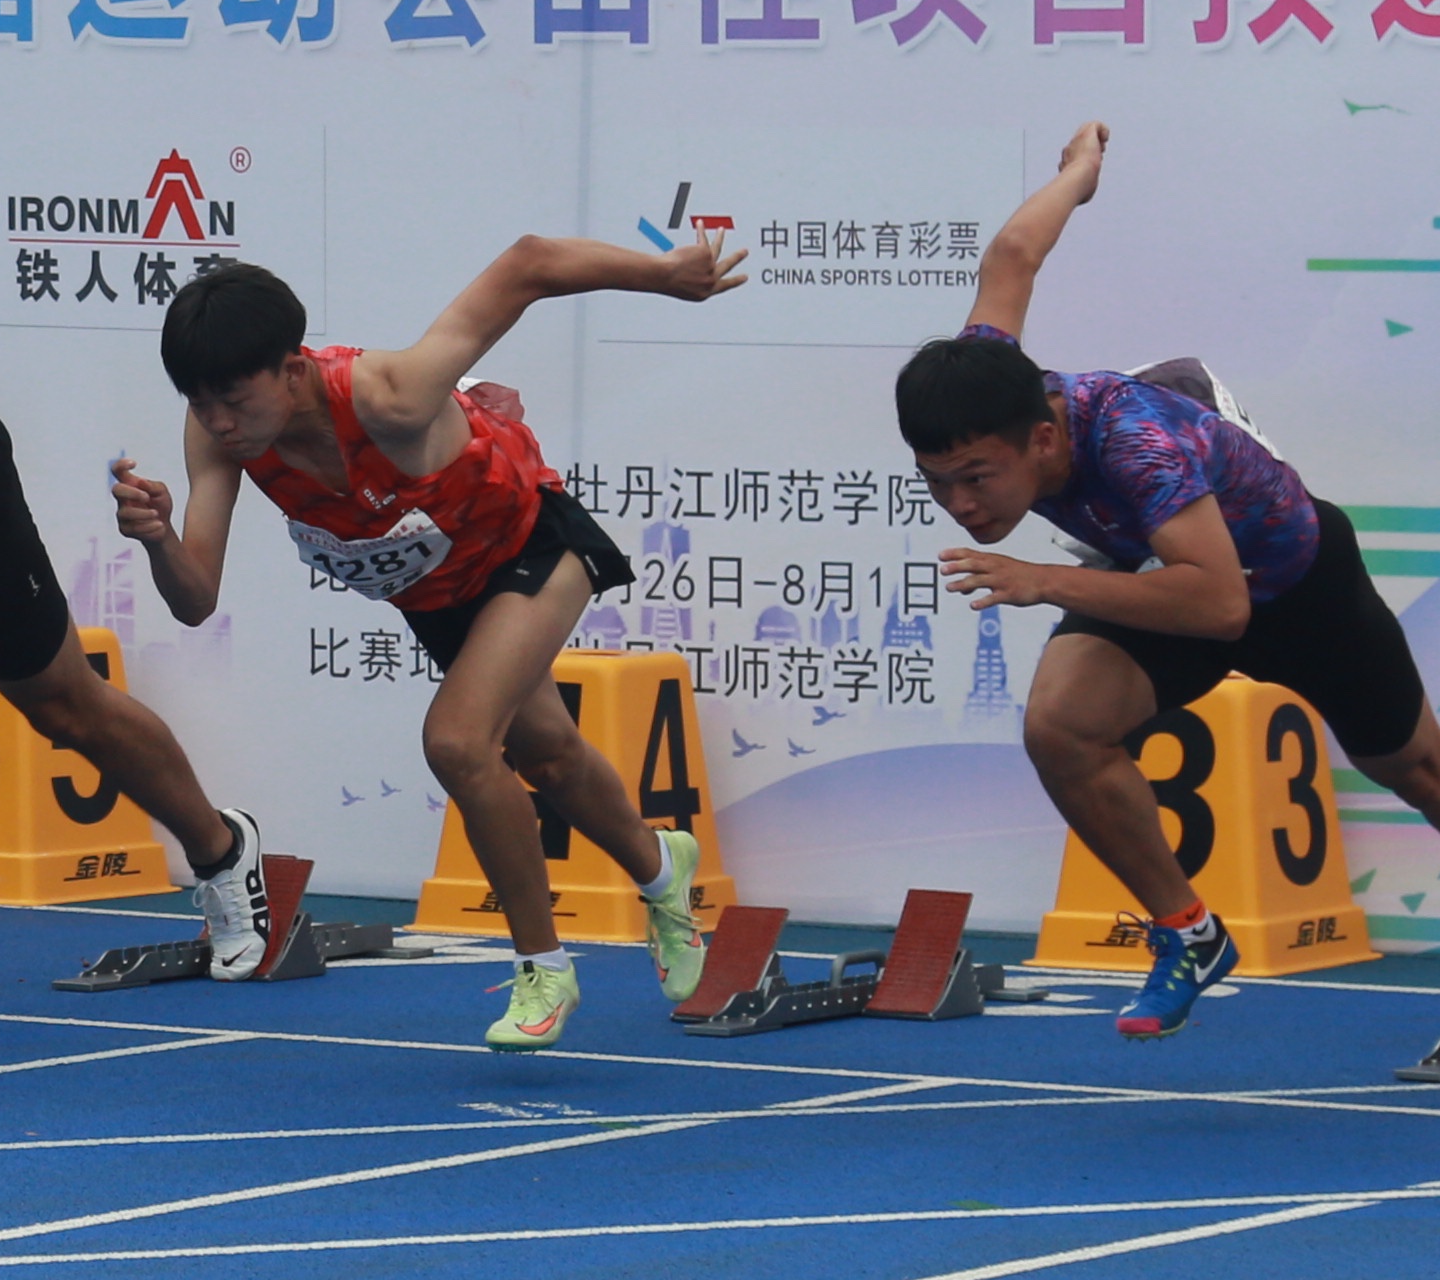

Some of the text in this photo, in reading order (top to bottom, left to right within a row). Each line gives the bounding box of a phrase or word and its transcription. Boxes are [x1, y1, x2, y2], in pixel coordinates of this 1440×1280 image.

[7, 148, 236, 241] IRONMAN
[760, 219, 981, 261] 中国体育彩票
[16, 249, 240, 306] 铁人体
[761, 267, 979, 288] CHINA SPORTS LOTTERY
[565, 462, 936, 527] 牡丹江师范学院
[313, 541, 433, 583] 1281
[567, 637, 936, 705] 江师范学院
[639, 678, 701, 833] 4
[1266, 703, 1327, 887] 3
